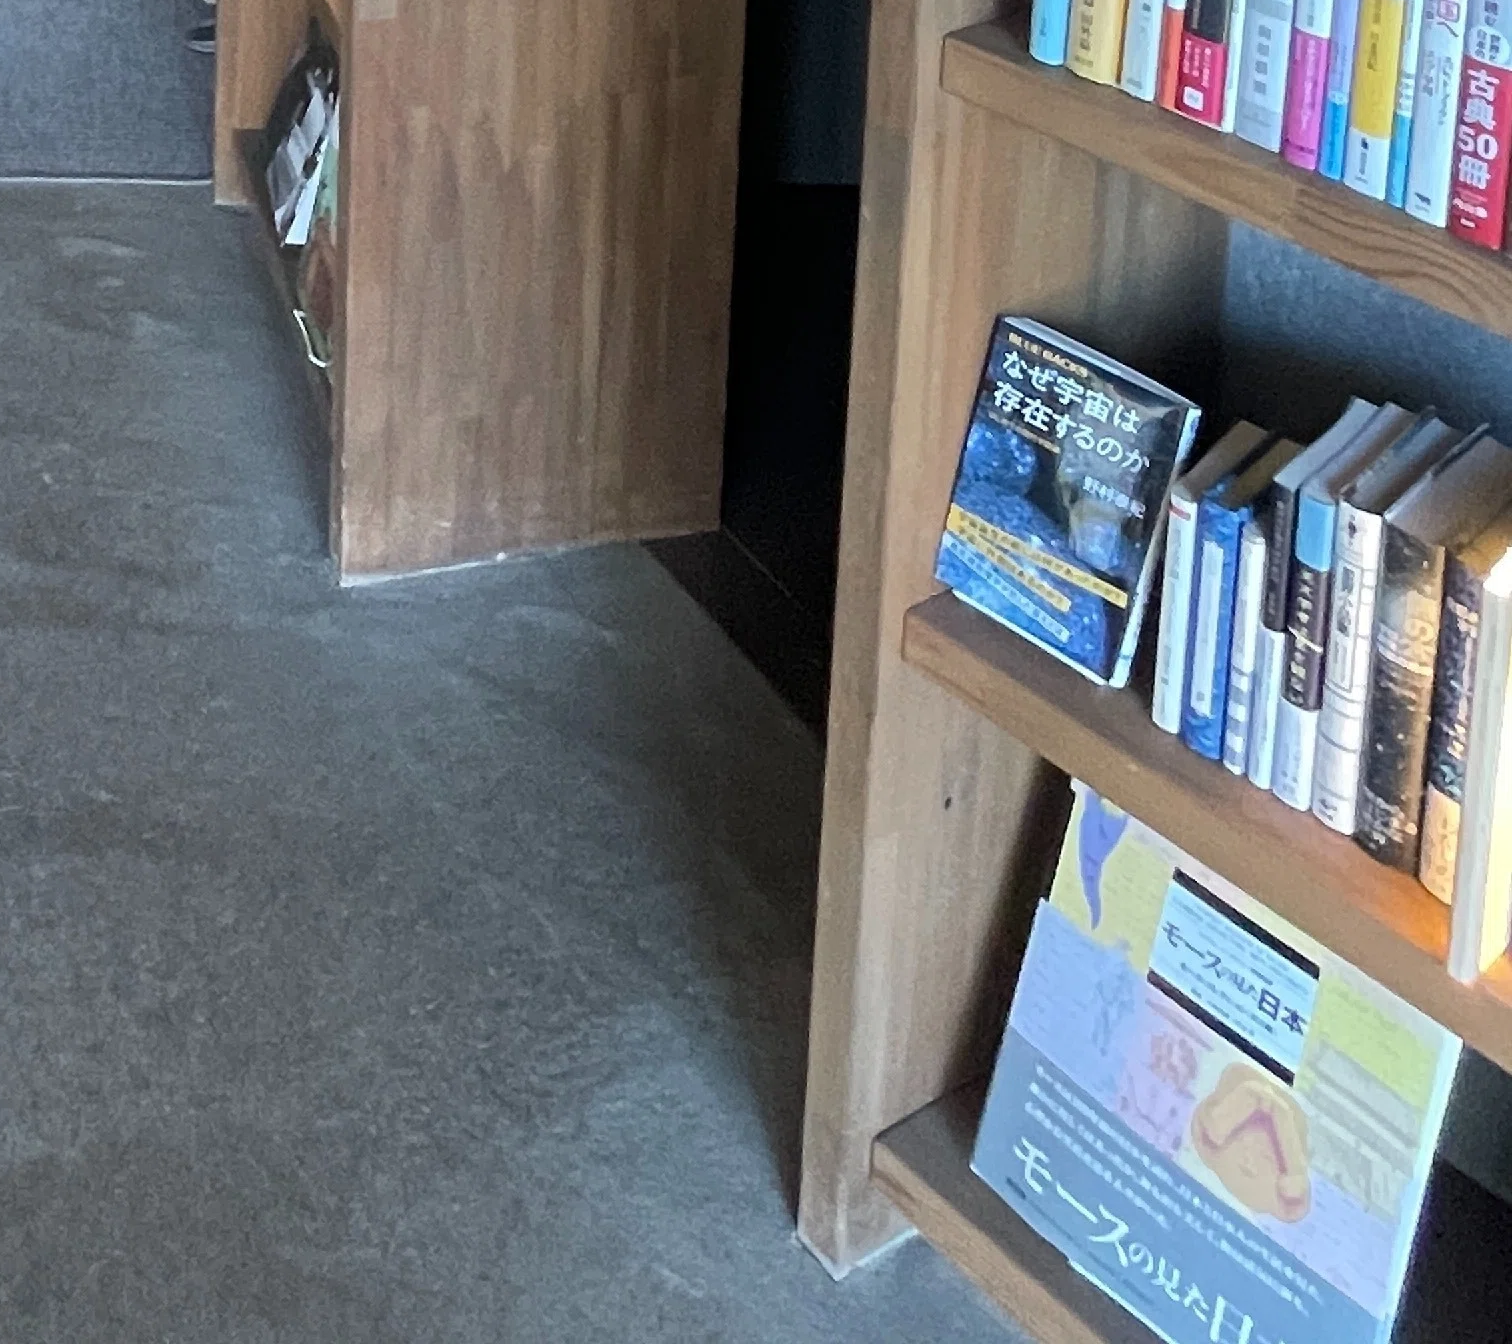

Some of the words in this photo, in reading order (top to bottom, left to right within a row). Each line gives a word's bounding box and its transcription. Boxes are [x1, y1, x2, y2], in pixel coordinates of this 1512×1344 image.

[993, 379, 1151, 474] 存在するのか
[1001, 349, 1143, 435] なぜ宇宙は
[1012, 1136, 1288, 1344] モースの見た日
